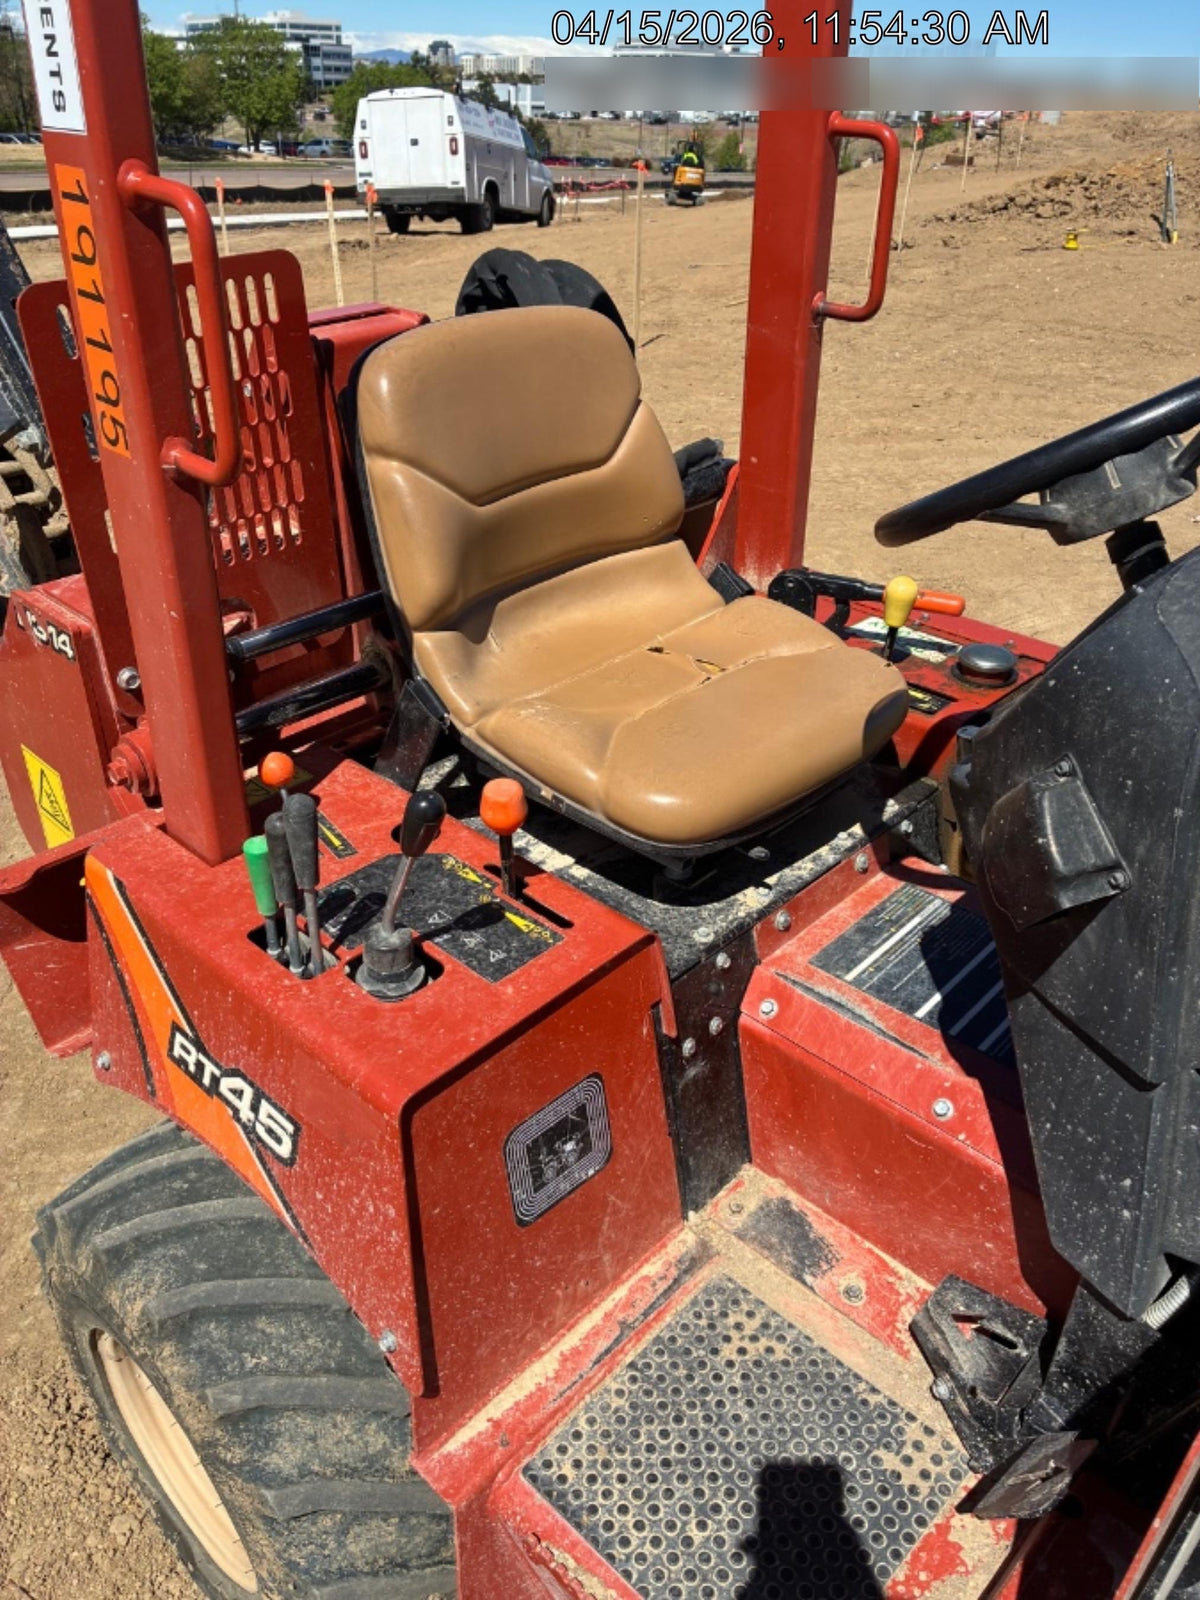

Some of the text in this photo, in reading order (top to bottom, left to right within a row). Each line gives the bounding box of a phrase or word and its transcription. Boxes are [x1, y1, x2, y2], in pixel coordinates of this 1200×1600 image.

[37, 0, 66, 113] ENTS
[61, 179, 129, 450] 191195
[172, 1030, 295, 1159] RT45
